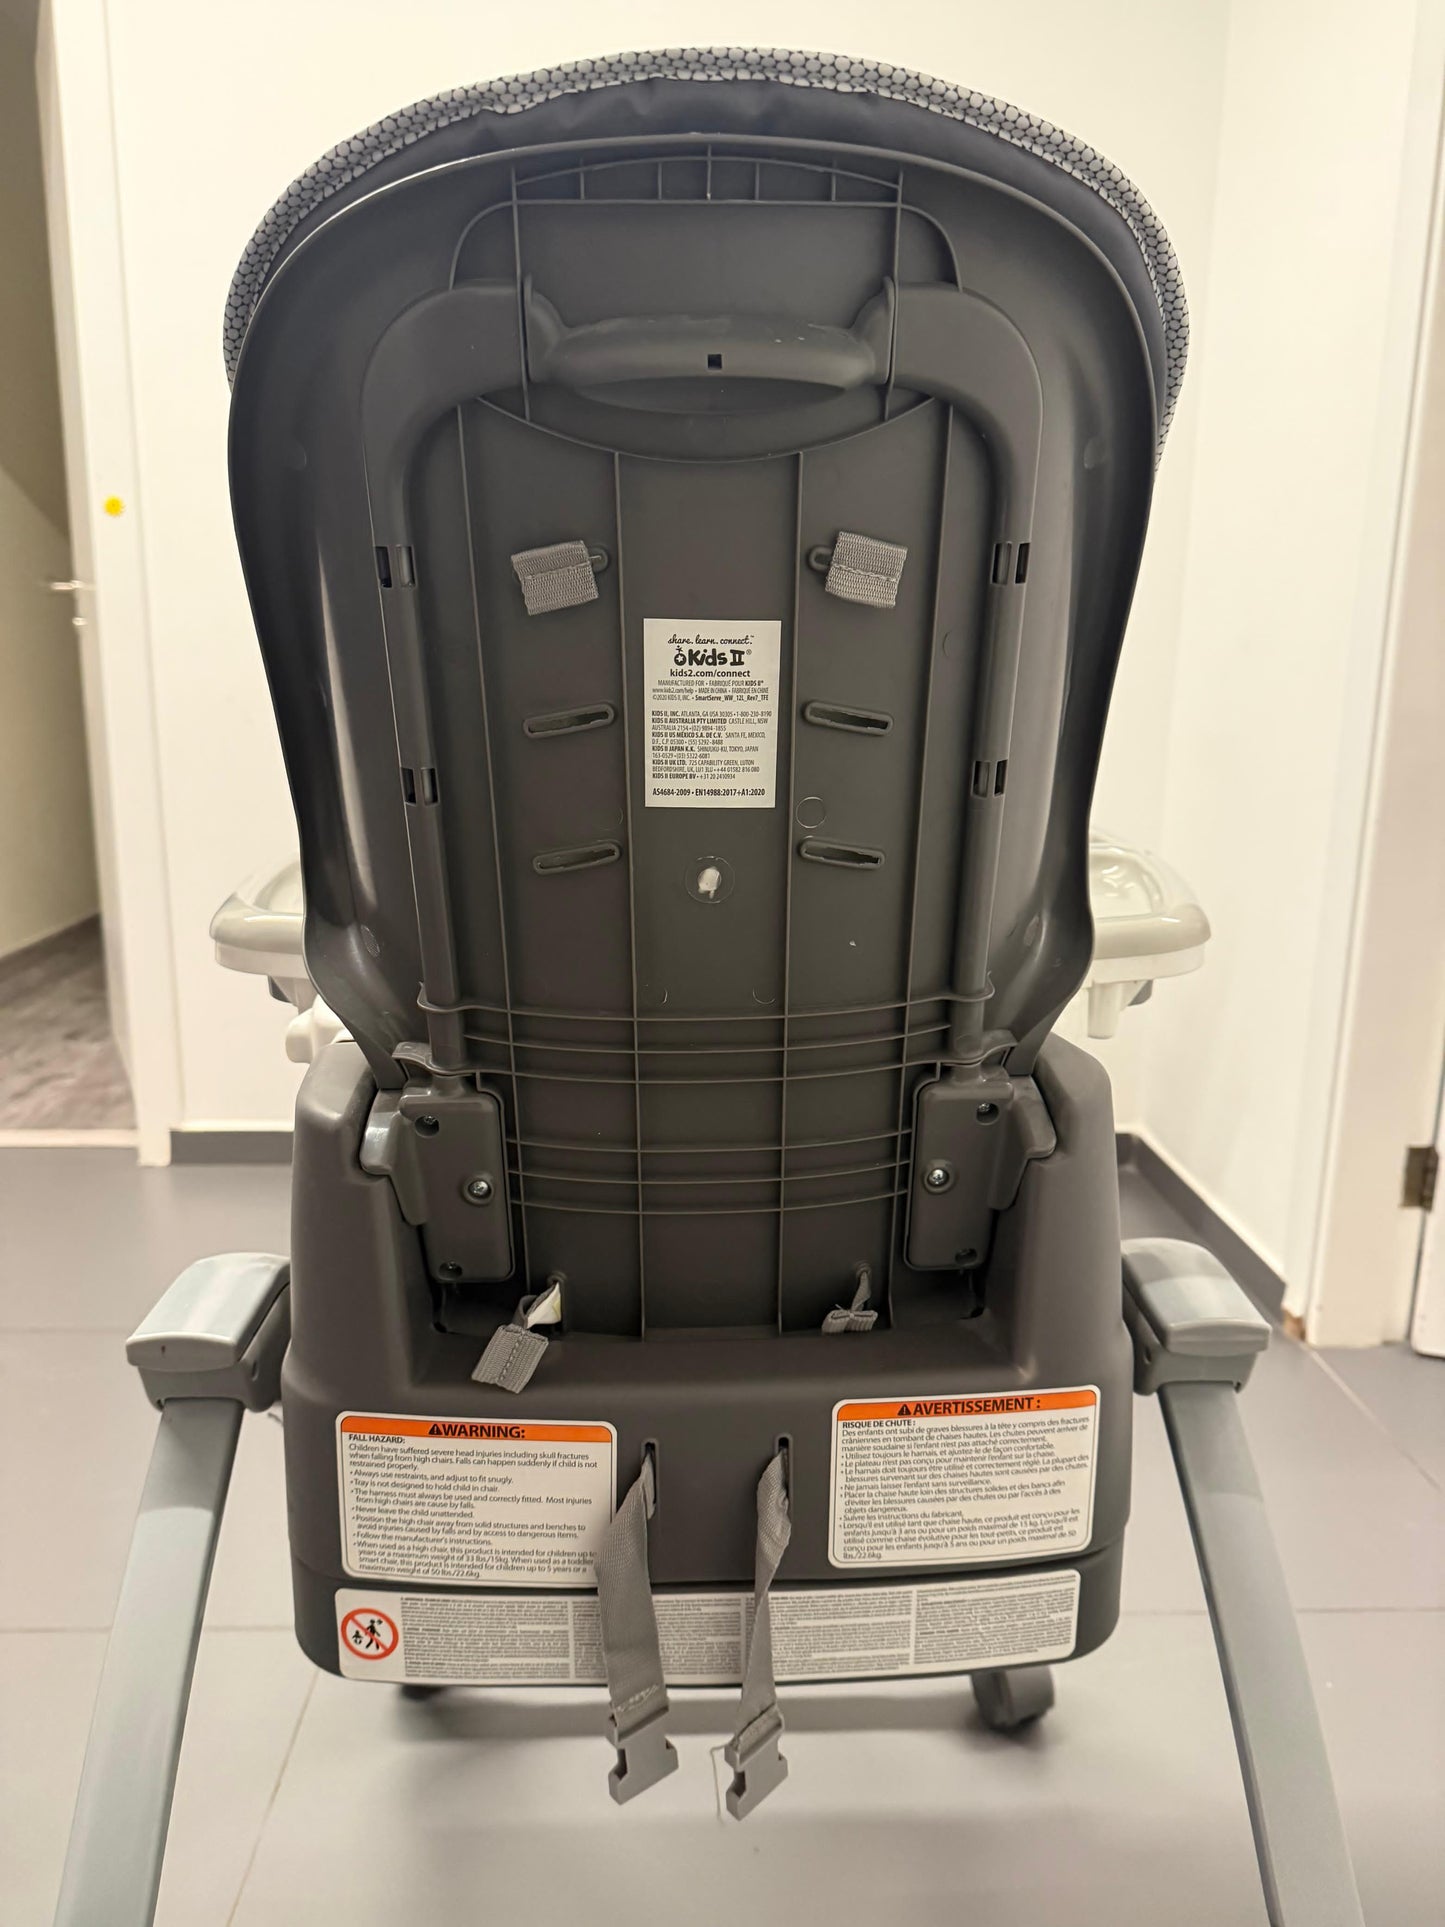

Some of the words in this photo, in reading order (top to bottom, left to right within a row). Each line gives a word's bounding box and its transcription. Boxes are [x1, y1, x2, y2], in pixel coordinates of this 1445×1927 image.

[668, 633, 694, 645] share.
[695, 633, 719, 645] learn.
[688, 648, 728, 666] Kids
[670, 668, 751, 678] kids2.com/connect
[658, 679, 694, 687] MANUFACTURED
[696, 679, 705, 687] FOR
[731, 679, 744, 687] POUR
[744, 679, 756, 687] KIDS
[652, 788, 691, 796] AS4684-2009
[695, 788, 766, 796] EN14988:2017+A1:2020
[913, 1397, 1035, 1416] AVERTISSEMENT
[441, 1423, 526, 1439] WARNING:
[842, 1421, 872, 1429] RISQUE
[873, 1420, 885, 1428] DE
[885, 1419, 912, 1427] CHUTE
[857, 1428, 884, 1436] enfants
[900, 1425, 914, 1433] subi
[950, 1423, 983, 1431] blessures
[998, 1421, 1012, 1429] tête
[1018, 1418, 1046, 1428] compris
[349, 1433, 368, 1442] FALL
[369, 1435, 406, 1444] HAZARD:
[349, 1443, 380, 1451] Children
[380, 1444, 399, 1452] have
[400, 1446, 429, 1455] suffered
[455, 1448, 475, 1456] head
[475, 1449, 501, 1458] injuries
[503, 1450, 538, 1460] including
[539, 1451, 556, 1459] skull
[557, 1451, 589, 1460] fractures
[350, 1451, 370, 1459] when
[371, 1452, 394, 1462] falling
[395, 1453, 414, 1461] from
[414, 1454, 431, 1464] high
[431, 1455, 454, 1464] chairs.
[456, 1456, 471, 1464] Falls
[487, 1458, 517, 1467] happen
[517, 1458, 552, 1468] suddenly
[552, 1459, 558, 1467] if
[559, 1459, 576, 1467] child
[577, 1460, 583, 1468] is
[350, 1459, 386, 1467] restrained
[387, 1461, 420, 1470] properly.
[354, 1468, 380, 1478] Always
[395, 1471, 429, 1480] restraints,
[430, 1472, 445, 1480] and
[445, 1473, 468, 1482] adjust
[478, 1474, 487, 1482] fit
[487, 1475, 514, 1485] snugly.
[354, 1478, 370, 1488] Tray
[391, 1480, 425, 1490] designed
[434, 1482, 451, 1490] hold
[452, 1483, 471, 1491] child
[480, 1484, 500, 1492] chair.
[355, 1486, 368, 1494] The
[369, 1487, 398, 1496] harness
[418, 1490, 442, 1500] always
[443, 1491, 453, 1499] be
[454, 1492, 471, 1500] used
[473, 1493, 488, 1501] and
[489, 1494, 521, 1504] correctly
[521, 1494, 543, 1503] fitted.
[545, 1495, 565, 1503] Most
[565, 1496, 592, 1505] injuries
